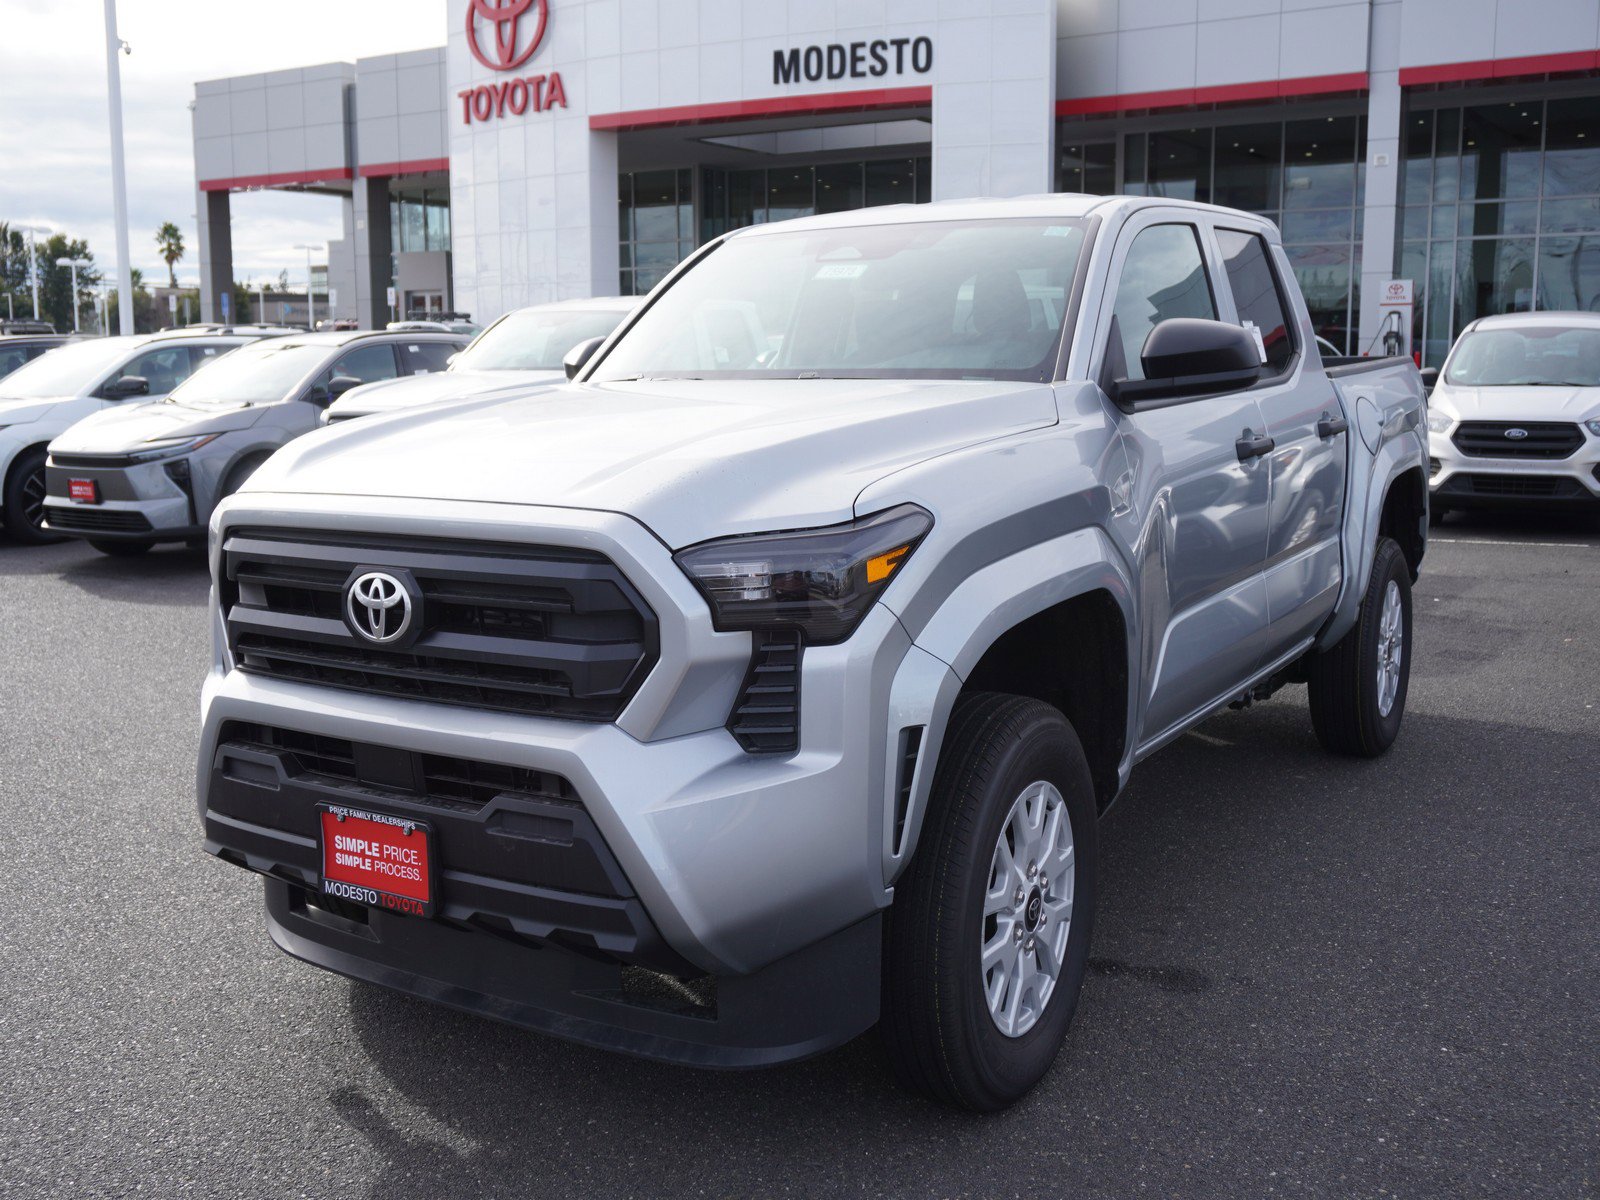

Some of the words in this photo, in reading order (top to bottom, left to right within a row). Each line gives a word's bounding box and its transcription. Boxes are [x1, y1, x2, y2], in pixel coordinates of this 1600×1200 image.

[773, 36, 933, 85] MODESTO
[457, 72, 568, 125] TOYOTA
[329, 806, 349, 817] PRICE
[349, 810, 371, 820] FAMILY
[372, 814, 416, 830] DEALERSHIPS
[334, 835, 380, 857] SIMPLE
[383, 844, 422, 866] PRICE.
[335, 852, 372, 871] SIMPLE
[374, 860, 422, 881] PROCESS.
[325, 881, 377, 903] MODESTO
[380, 893, 424, 916] TOYOTA
